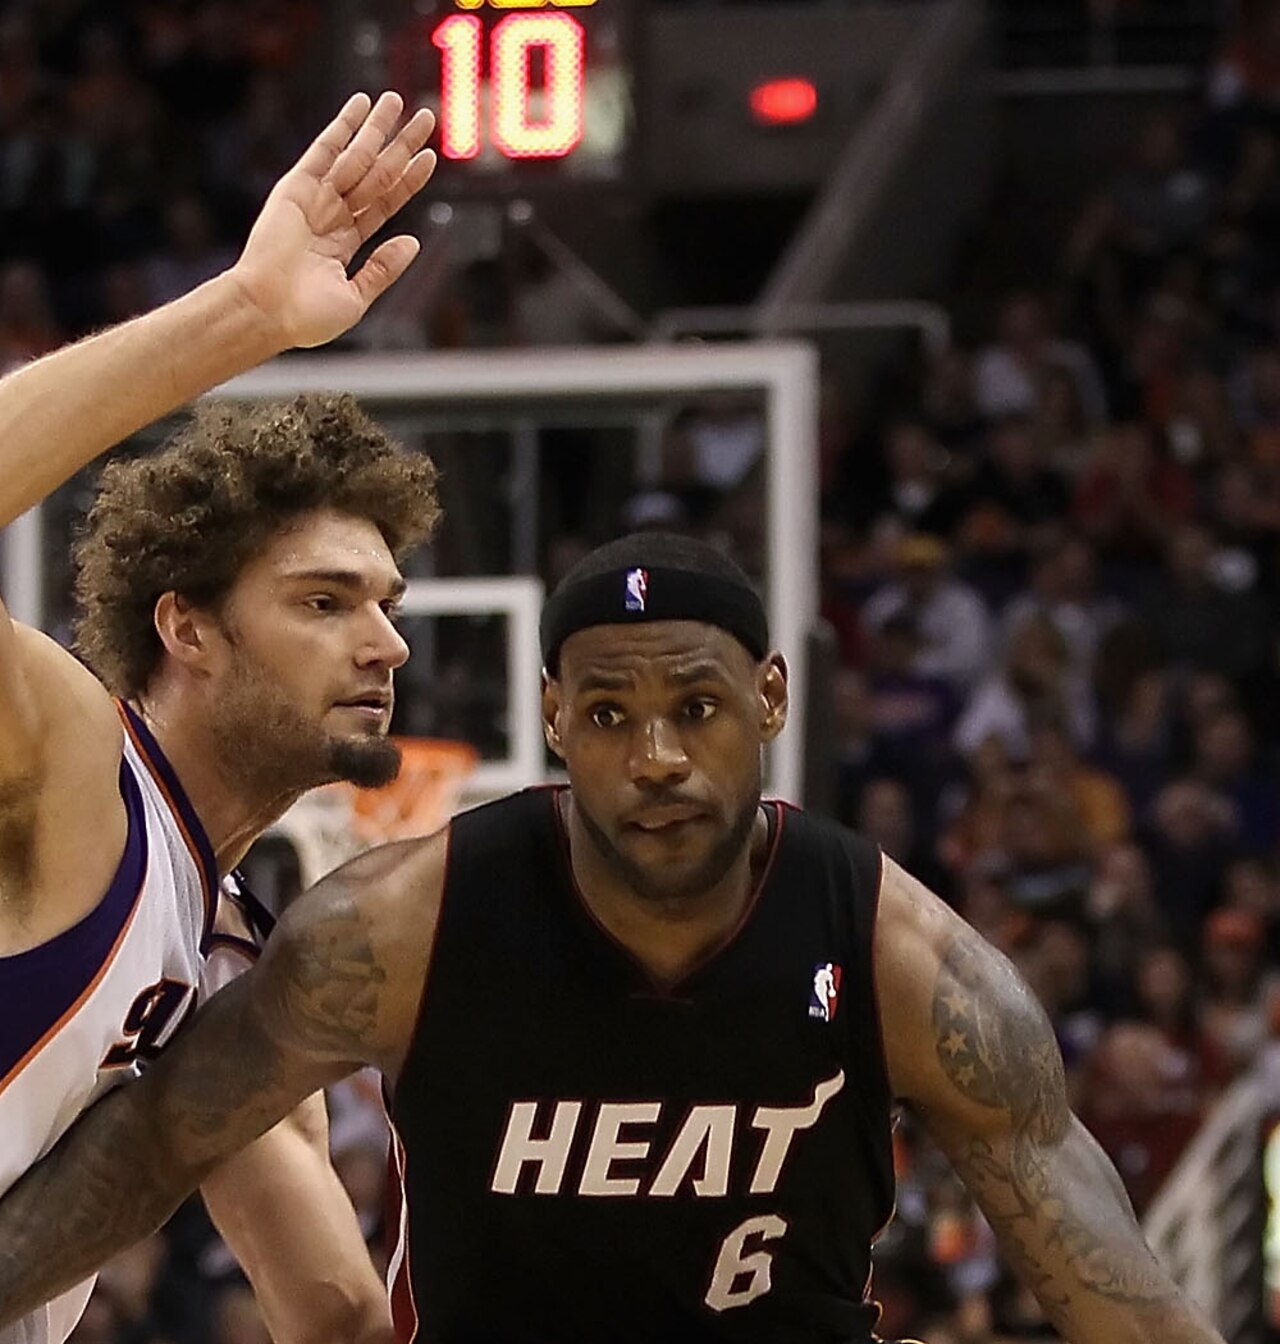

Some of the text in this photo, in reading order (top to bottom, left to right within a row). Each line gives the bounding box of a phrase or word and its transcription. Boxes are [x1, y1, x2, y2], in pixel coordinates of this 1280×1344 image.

[432, 12, 586, 160] 10
[490, 1068, 846, 1198] HEAT
[704, 1213, 789, 1314] 6
